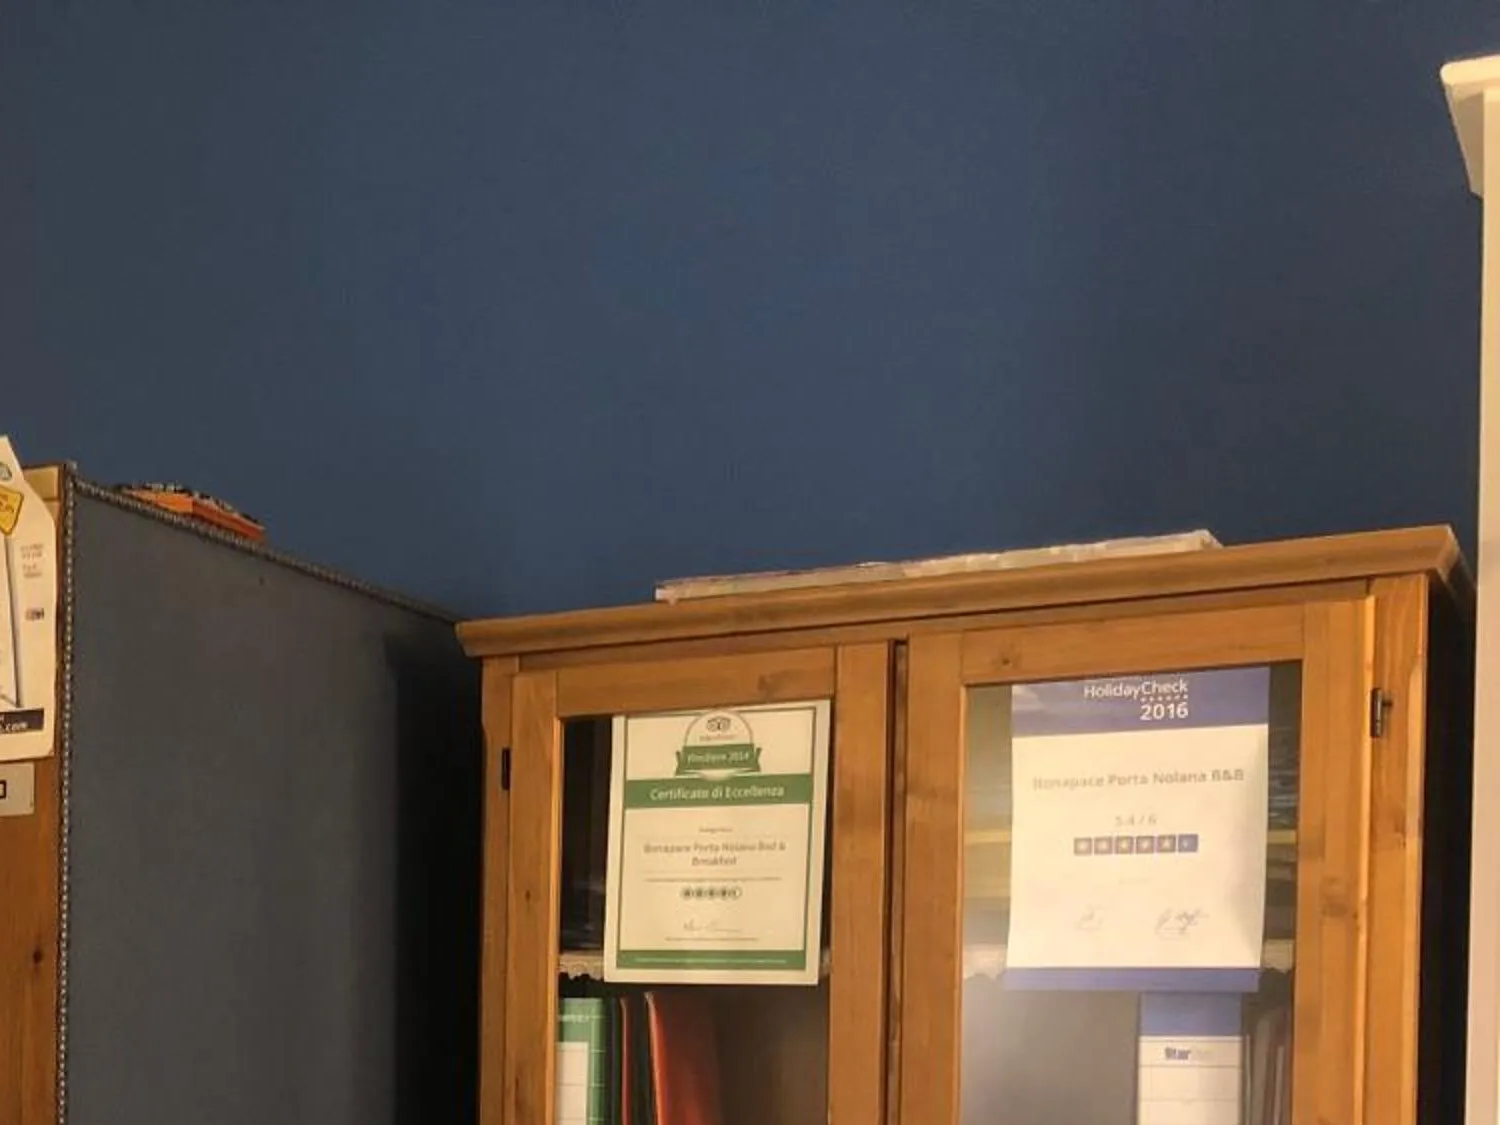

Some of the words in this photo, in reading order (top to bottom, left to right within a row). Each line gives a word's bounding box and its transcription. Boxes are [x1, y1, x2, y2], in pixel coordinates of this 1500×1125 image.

[1084, 679, 1189, 701] HolidayCheck
[1140, 702, 1189, 721] 2016
[1108, 772, 1149, 787] Porta
[1153, 770, 1207, 785] Nolana
[650, 787, 709, 801] Certificato
[712, 786, 723, 798] di
[725, 785, 785, 799] Eccellenza
